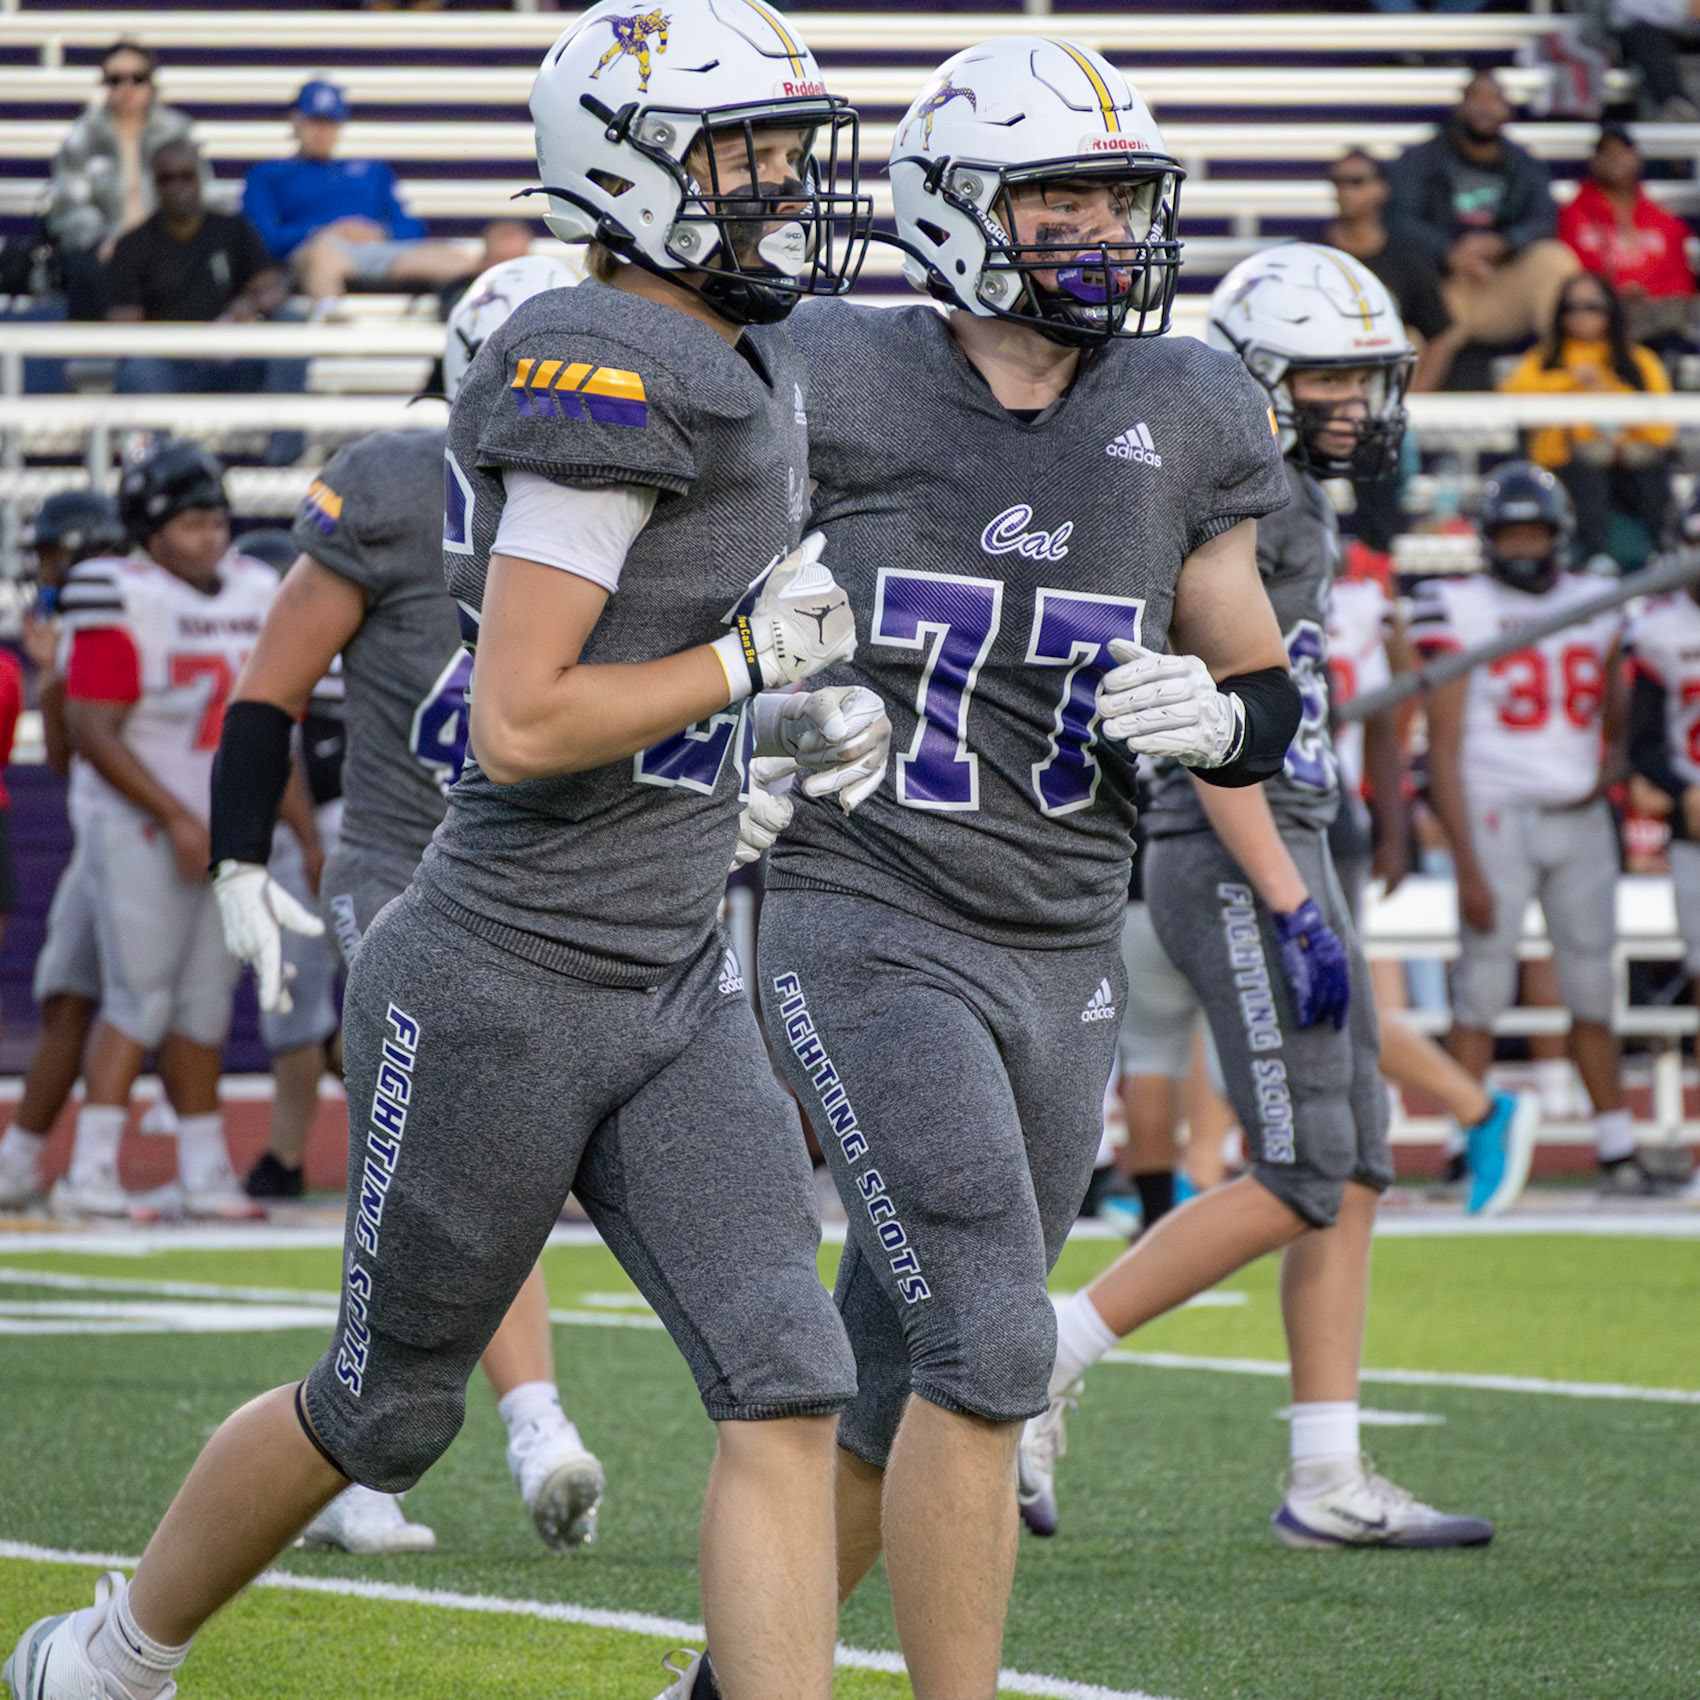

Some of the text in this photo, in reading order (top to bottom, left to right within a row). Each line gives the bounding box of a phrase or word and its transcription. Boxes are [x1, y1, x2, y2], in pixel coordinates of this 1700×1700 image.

[783, 81, 827, 96] Riddell
[1105, 444, 1162, 468] adidas
[980, 503, 1075, 561] Cal
[740, 628, 751, 648] Can
[744, 649, 756, 664] Be
[871, 567, 1147, 817] 77
[1081, 1005, 1116, 1022] adidas
[1217, 881, 1296, 1165] FIGHTING SCOTS
[773, 970, 932, 1305] FIGHTING SCOTS
[335, 1001, 421, 1398] FIGHTING SCOTS
